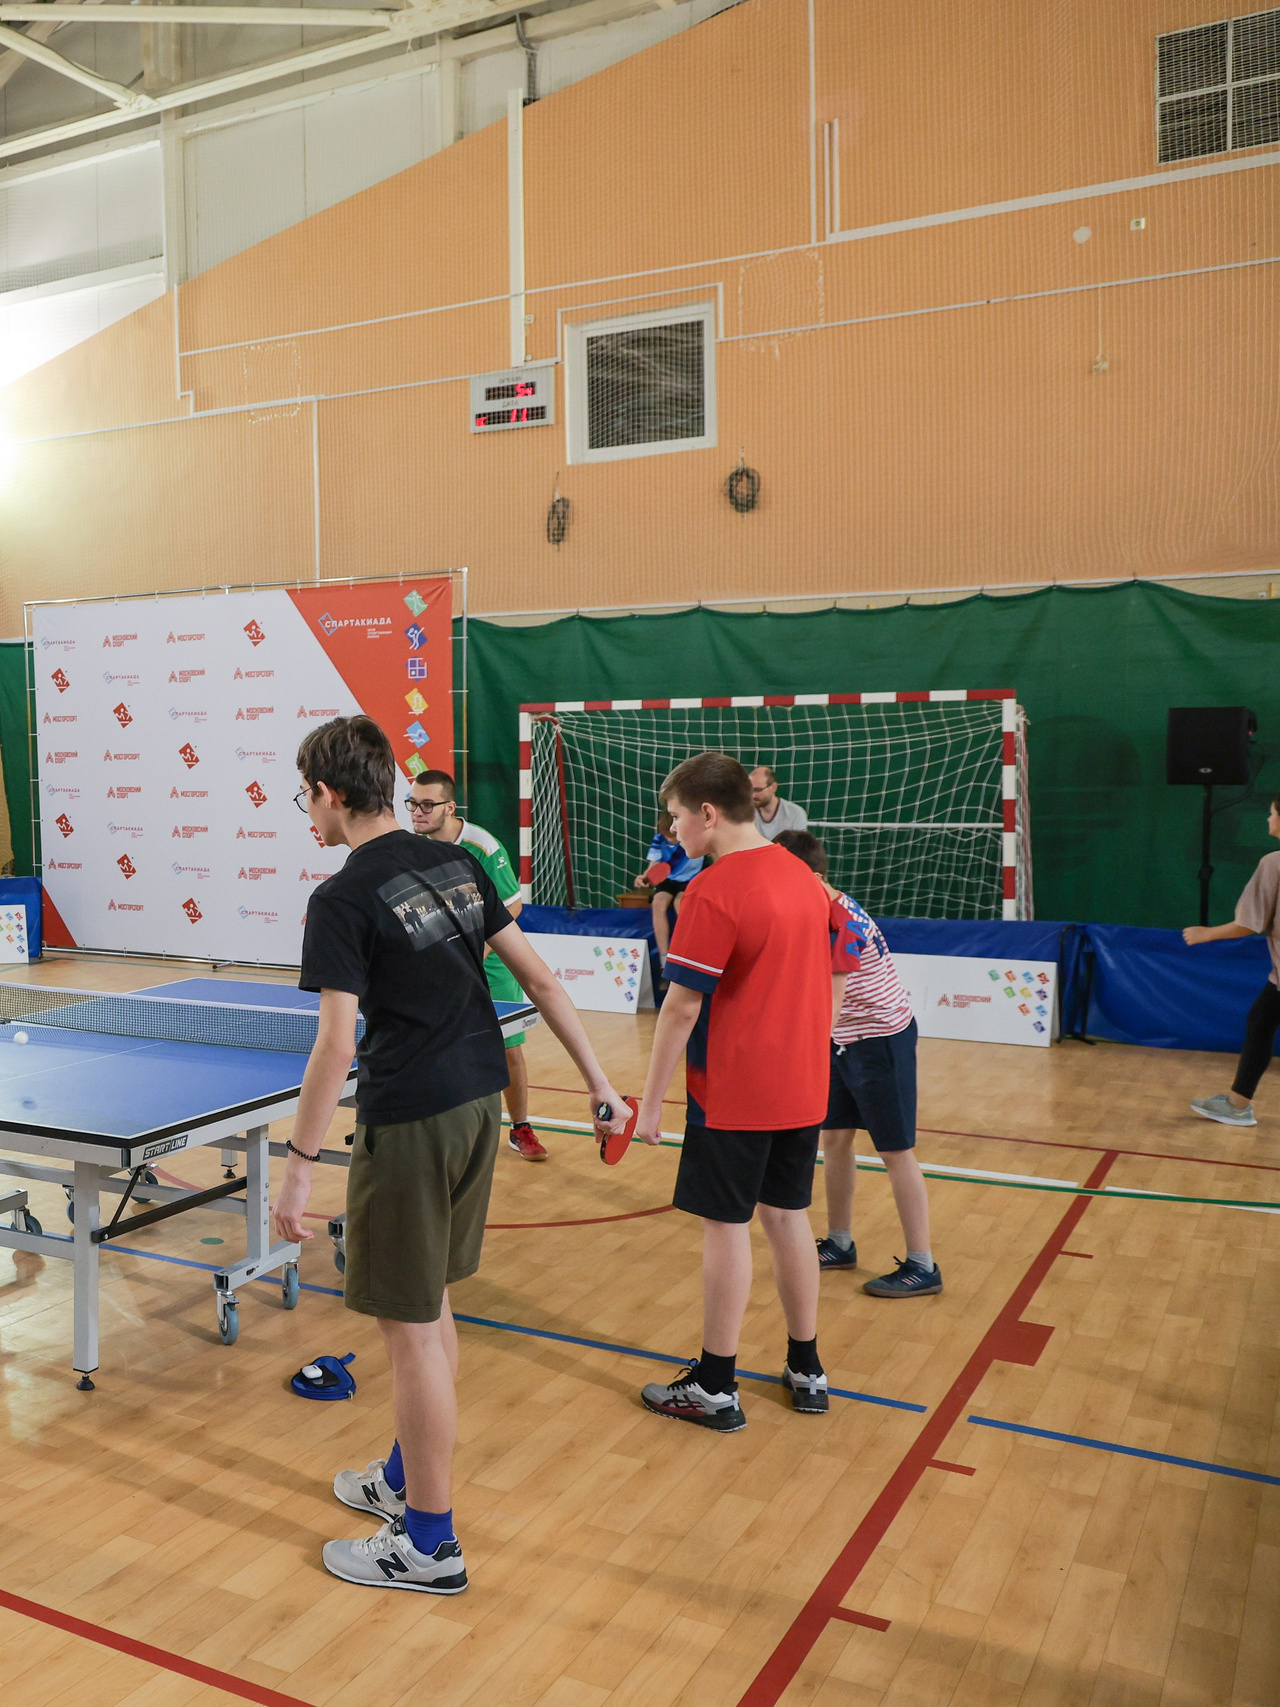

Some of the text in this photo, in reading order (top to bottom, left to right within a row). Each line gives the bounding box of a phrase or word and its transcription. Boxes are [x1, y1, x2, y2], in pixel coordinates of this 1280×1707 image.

[325, 617, 392, 628] СПАРТАКИАДА
[112, 633, 138, 641] МОСКОВСКИЙ
[177, 633, 206, 642] МОСГОРСПОРТ
[178, 669, 206, 677] МОСКОВСКИЙ
[244, 670, 275, 678] МОСГОРСПОРТ
[246, 706, 275, 714] МОСКОВСКИЙ
[308, 708, 340, 717] МОСГОРСПОРТ
[180, 790, 209, 798] МОСГОРСПОРТ
[181, 825, 208, 833] МОСКОВСКИЙ
[247, 831, 277, 839] МОСГОРСПОРТ
[248, 867, 277, 875] МОСКОВСКИЙ
[145, 1137, 186, 1158] START LINE
